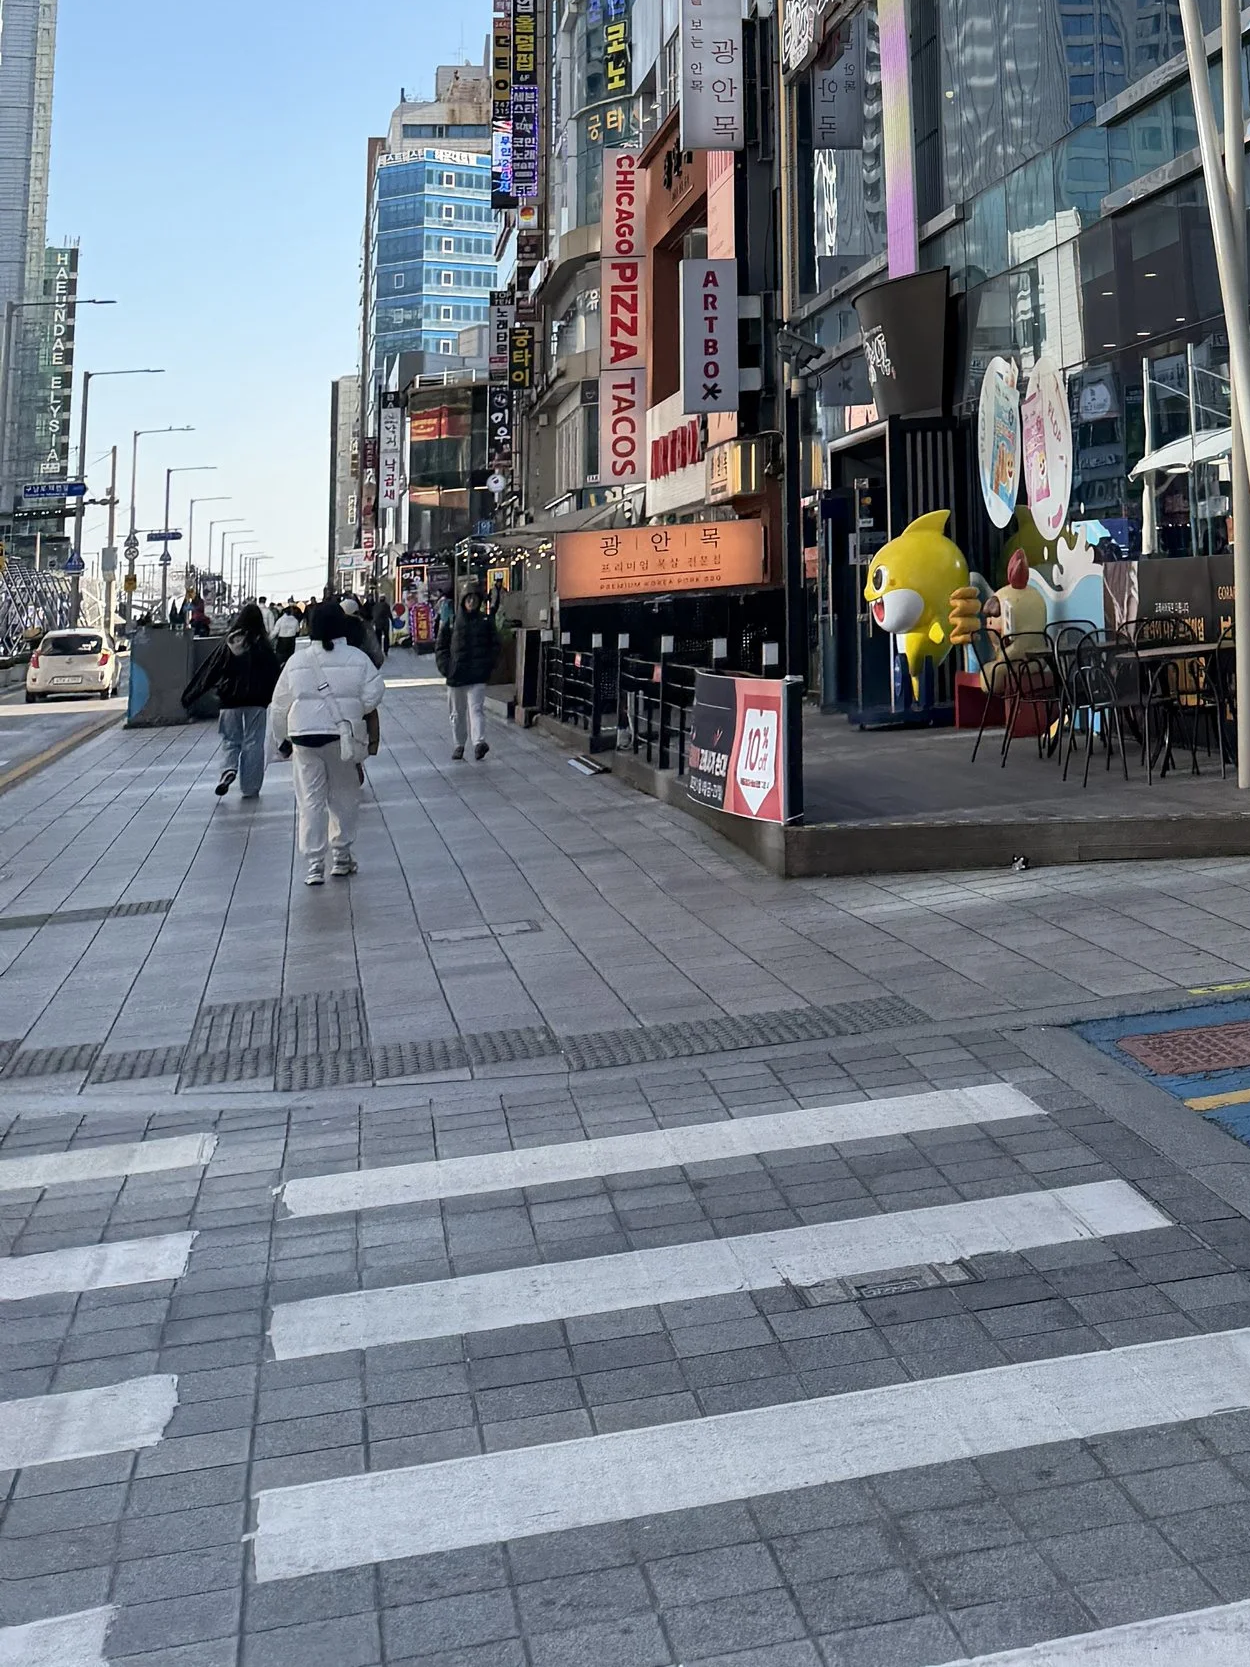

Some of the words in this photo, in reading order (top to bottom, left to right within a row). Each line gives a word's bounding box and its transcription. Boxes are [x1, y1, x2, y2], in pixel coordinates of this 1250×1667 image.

[689, 63, 705, 93] 안목
[690, 19, 704, 49] 보는
[711, 38, 738, 142] 광안목
[614, 154, 636, 255] CHICAGO
[52, 253, 69, 365] HAEUNDAE
[512, 330, 532, 387] 궁타이
[610, 261, 639, 365] PIZZA
[702, 270, 723, 401] ARTBOX
[47, 376, 62, 461] ELYSIA
[611, 376, 637, 477] TACOS
[600, 582, 641, 590] PREMIUM
